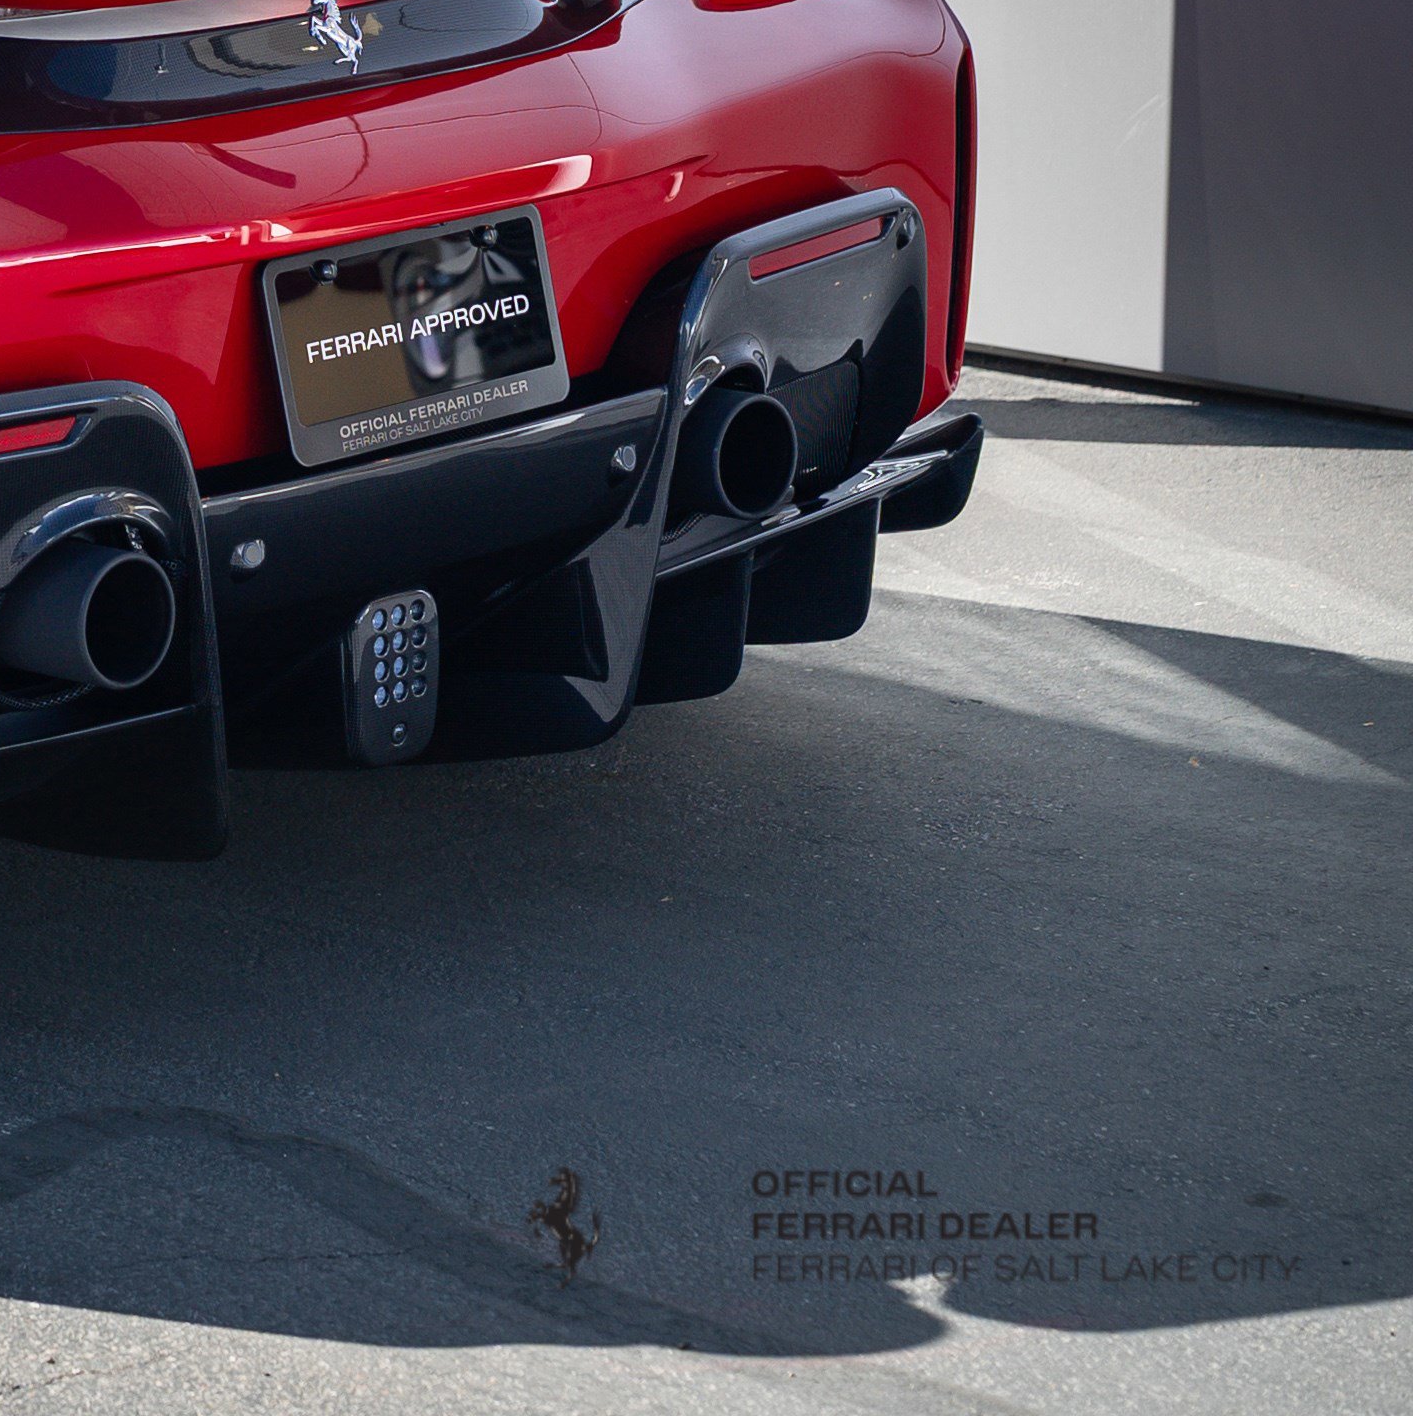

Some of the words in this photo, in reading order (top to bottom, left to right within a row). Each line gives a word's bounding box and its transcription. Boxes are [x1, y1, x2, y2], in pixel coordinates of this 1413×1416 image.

[306, 323, 404, 363] FERRARI
[410, 294, 529, 340] APPROVED
[340, 411, 407, 439] OFFICIAL
[409, 394, 471, 424] FERRARI
[473, 379, 529, 405] DEALER
[342, 432, 388, 452] FERRARI
[389, 426, 404, 441] OF
[405, 421, 430, 438] SALT
[431, 414, 460, 433] LAKE
[460, 406, 484, 427] CITY
